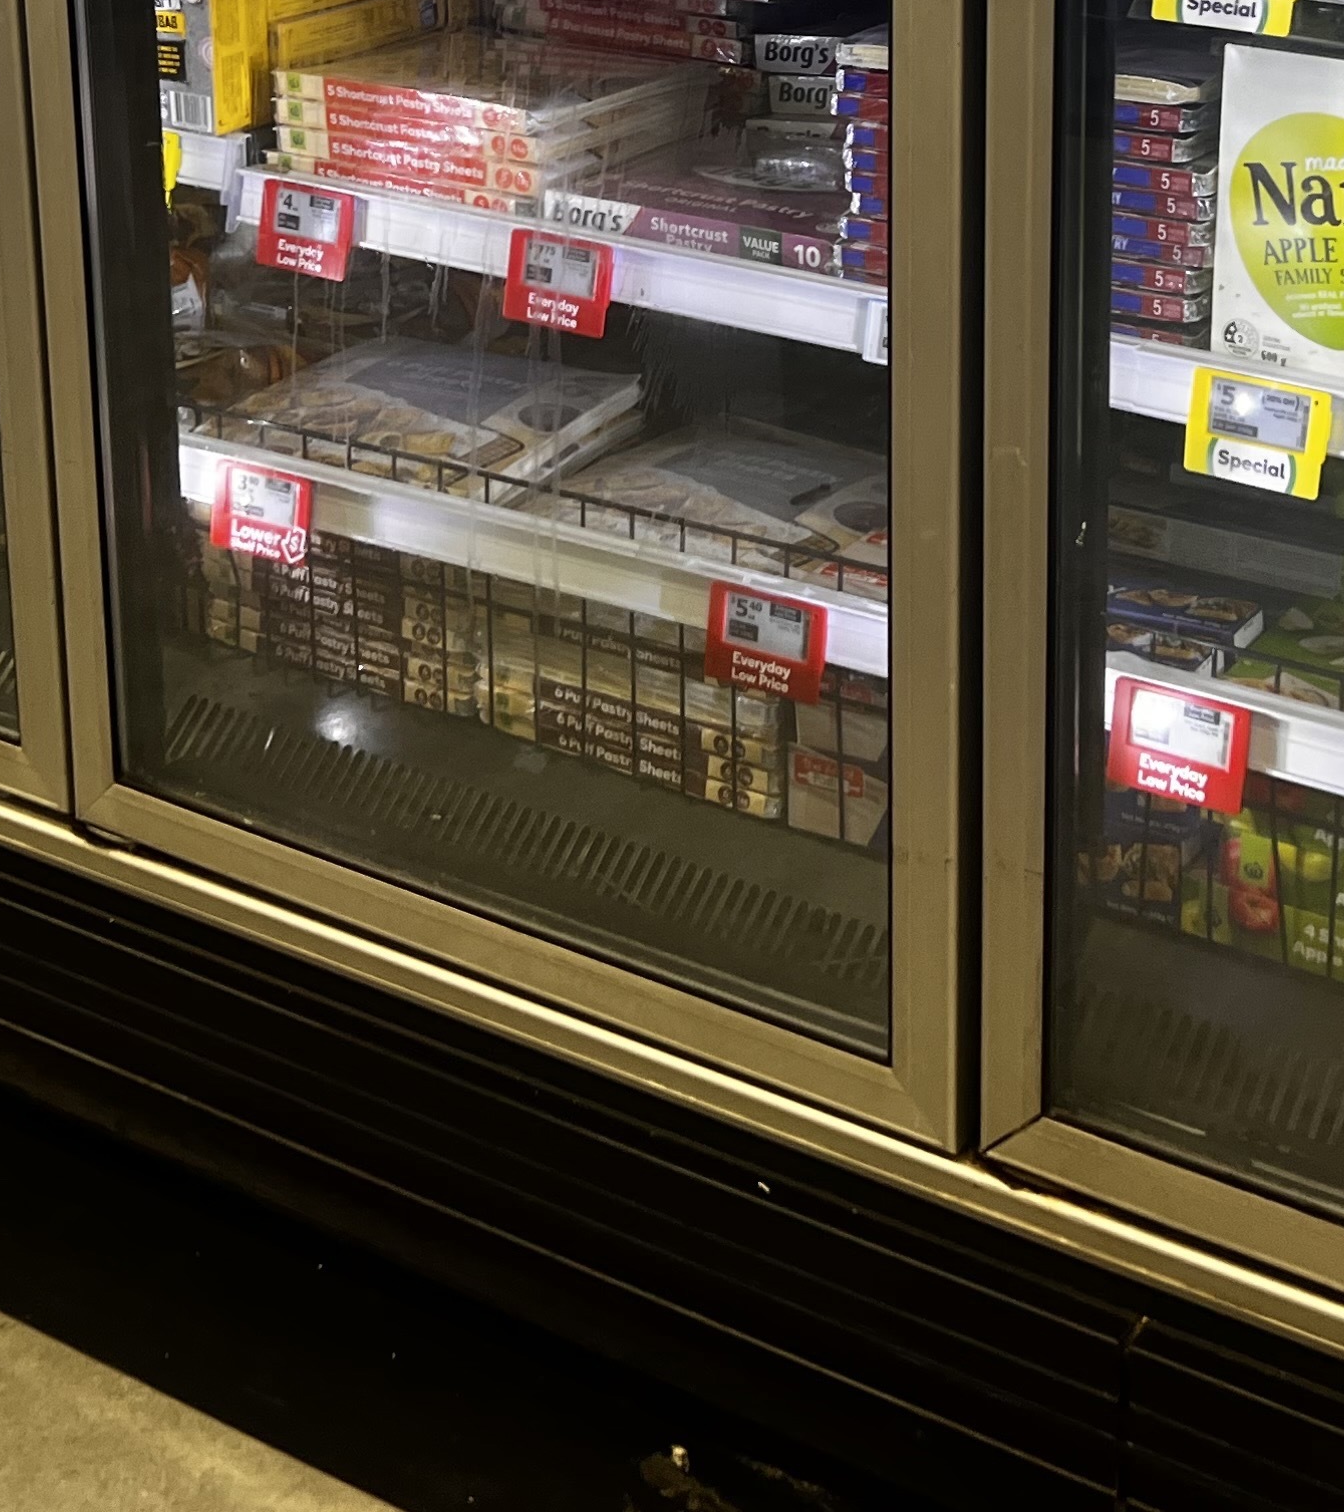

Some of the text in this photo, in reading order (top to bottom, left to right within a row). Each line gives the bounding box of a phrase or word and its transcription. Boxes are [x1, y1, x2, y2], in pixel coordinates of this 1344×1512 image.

[764, 40, 828, 67] Borg's
[1150, 110, 1160, 126] 5
[441, 160, 484, 179] Sheets
[1161, 172, 1170, 188] 5
[650, 216, 728, 243] Shortcrust
[277, 239, 324, 260] Everyday
[742, 236, 821, 268] VALUE 10
[1263, 238, 1338, 266] APPLE
[276, 256, 322, 274] Low Price
[1274, 269, 1333, 285] FAMILY
[1217, 448, 1287, 480] Special
[230, 520, 281, 546] Lower
[732, 652, 791, 679] Everyday
[731, 667, 790, 693] Low Price
[1138, 753, 1208, 788] Everyday
[1137, 769, 1206, 803] Low Price
